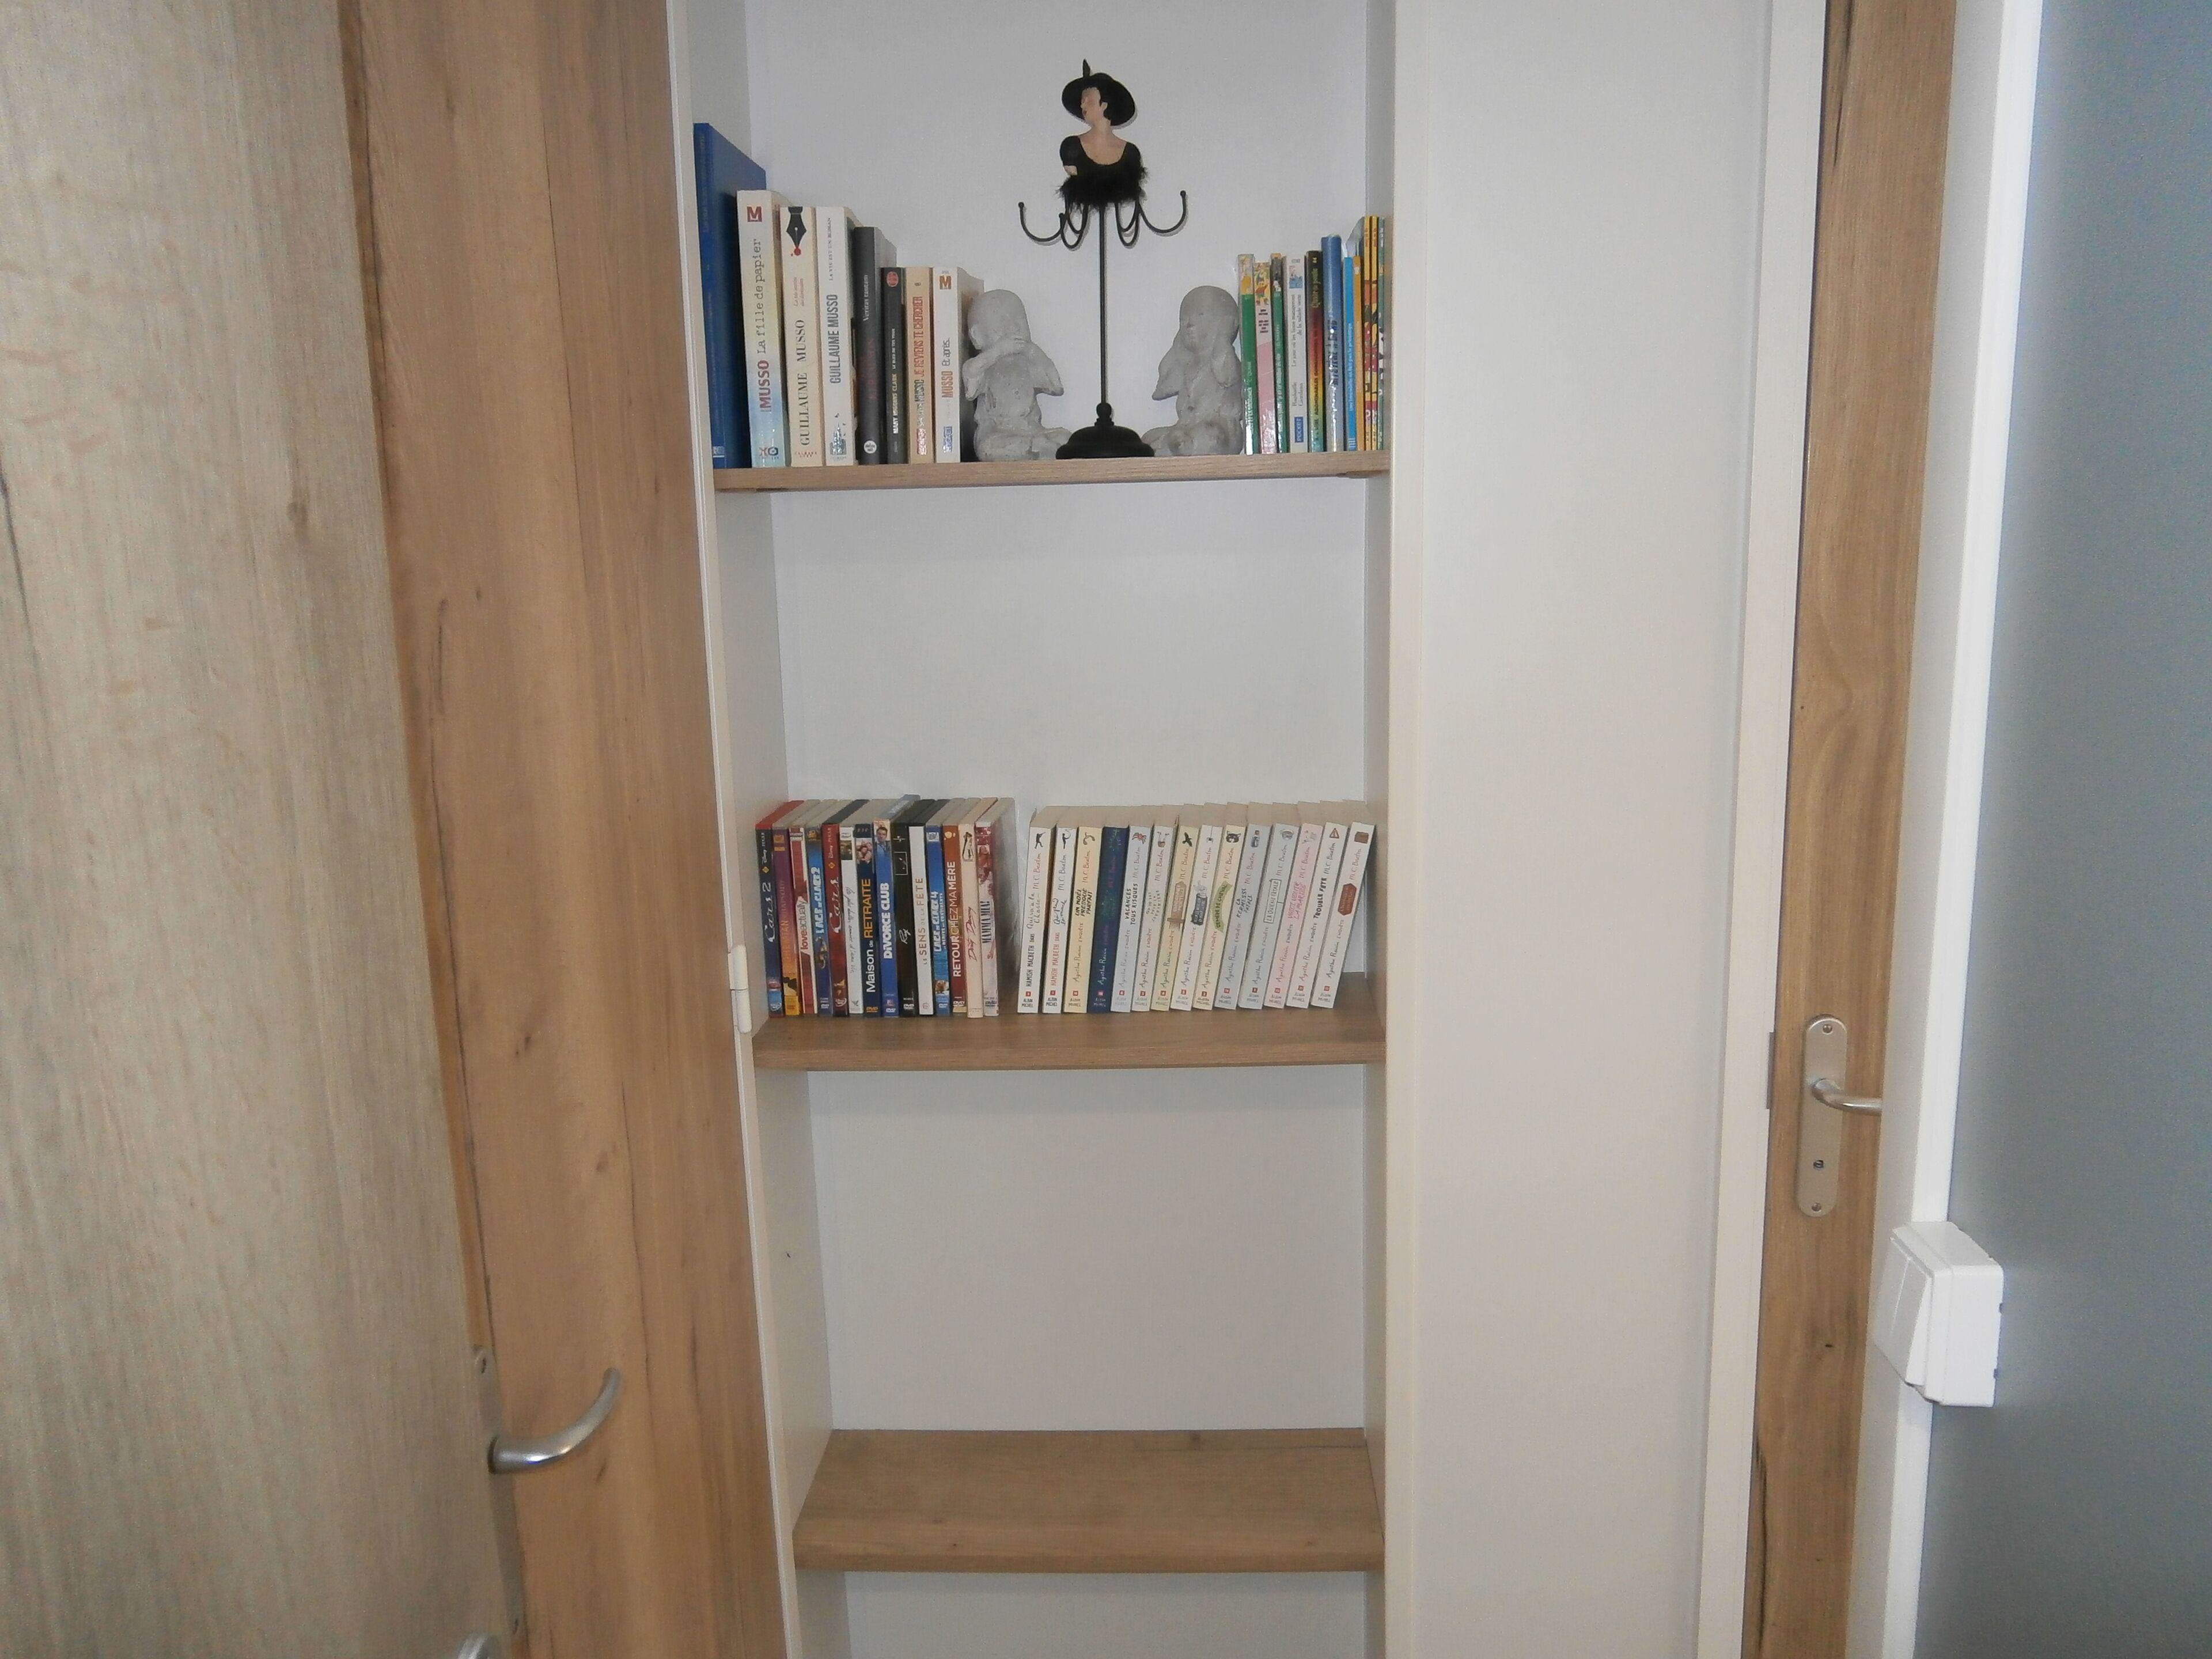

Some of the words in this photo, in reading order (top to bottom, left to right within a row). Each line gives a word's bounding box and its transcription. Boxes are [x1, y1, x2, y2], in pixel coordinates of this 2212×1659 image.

[753, 238, 765, 283] papier
[753, 286, 763, 300] de
[755, 303, 765, 336] fille
[826, 294, 839, 327] MUSSO
[912, 297, 923, 329] CHERCHER
[757, 340, 766, 354] La
[795, 320, 806, 362] MUSSO
[828, 331, 841, 383] GUILLAUME
[757, 360, 771, 409] MUSSO
[941, 371, 953, 397] MUSSO
[797, 373, 809, 445] GUILLAUME
[1033, 853, 1041, 873] Beaton
[947, 862, 956, 889] MÈRE
[762, 882, 771, 892] 2
[880, 883, 891, 910] CLUB
[829, 877, 841, 933] Cars
[862, 879, 873, 938] RETRAITE
[949, 891, 957, 907] MA
[980, 901, 991, 916] MIA!
[1313, 893, 1323, 919] TROUBLE
[764, 895, 775, 942] Cars
[949, 908, 959, 935] CHEZ
[1075, 907, 1080, 916] UN
[981, 917, 991, 944] MAMMA
[918, 927, 927, 956] SENS
[1330, 942, 1339, 957] Raisin
[950, 935, 961, 976] RETOUR
[1051, 944, 1059, 965] MACBETH
[1099, 948, 1107, 964] Raisin
[1141, 951, 1149, 967] Raisin
[1163, 952, 1172, 967] Raisin
[1184, 949, 1192, 965] Raisin
[1205, 952, 1214, 967] Raisin
[1229, 945, 1237, 961] Raisin
[1256, 948, 1264, 964] Raisin
[1303, 945, 1312, 960] Raisin
[866, 949, 876, 993] Maison
[1050, 968, 1058, 986] HAMISH
[1097, 965, 1107, 985] Agatha
[1139, 968, 1148, 988] Agatha
[1160, 968, 1169, 988] Agatha
[1181, 967, 1190, 986] Agatha
[1202, 969, 1211, 988] Agatha
[1225, 963, 1234, 982] Agatha
[1252, 965, 1262, 984] Agatha
[1299, 963, 1308, 981] Agatha
[1326, 959, 1335, 978] Agatha
